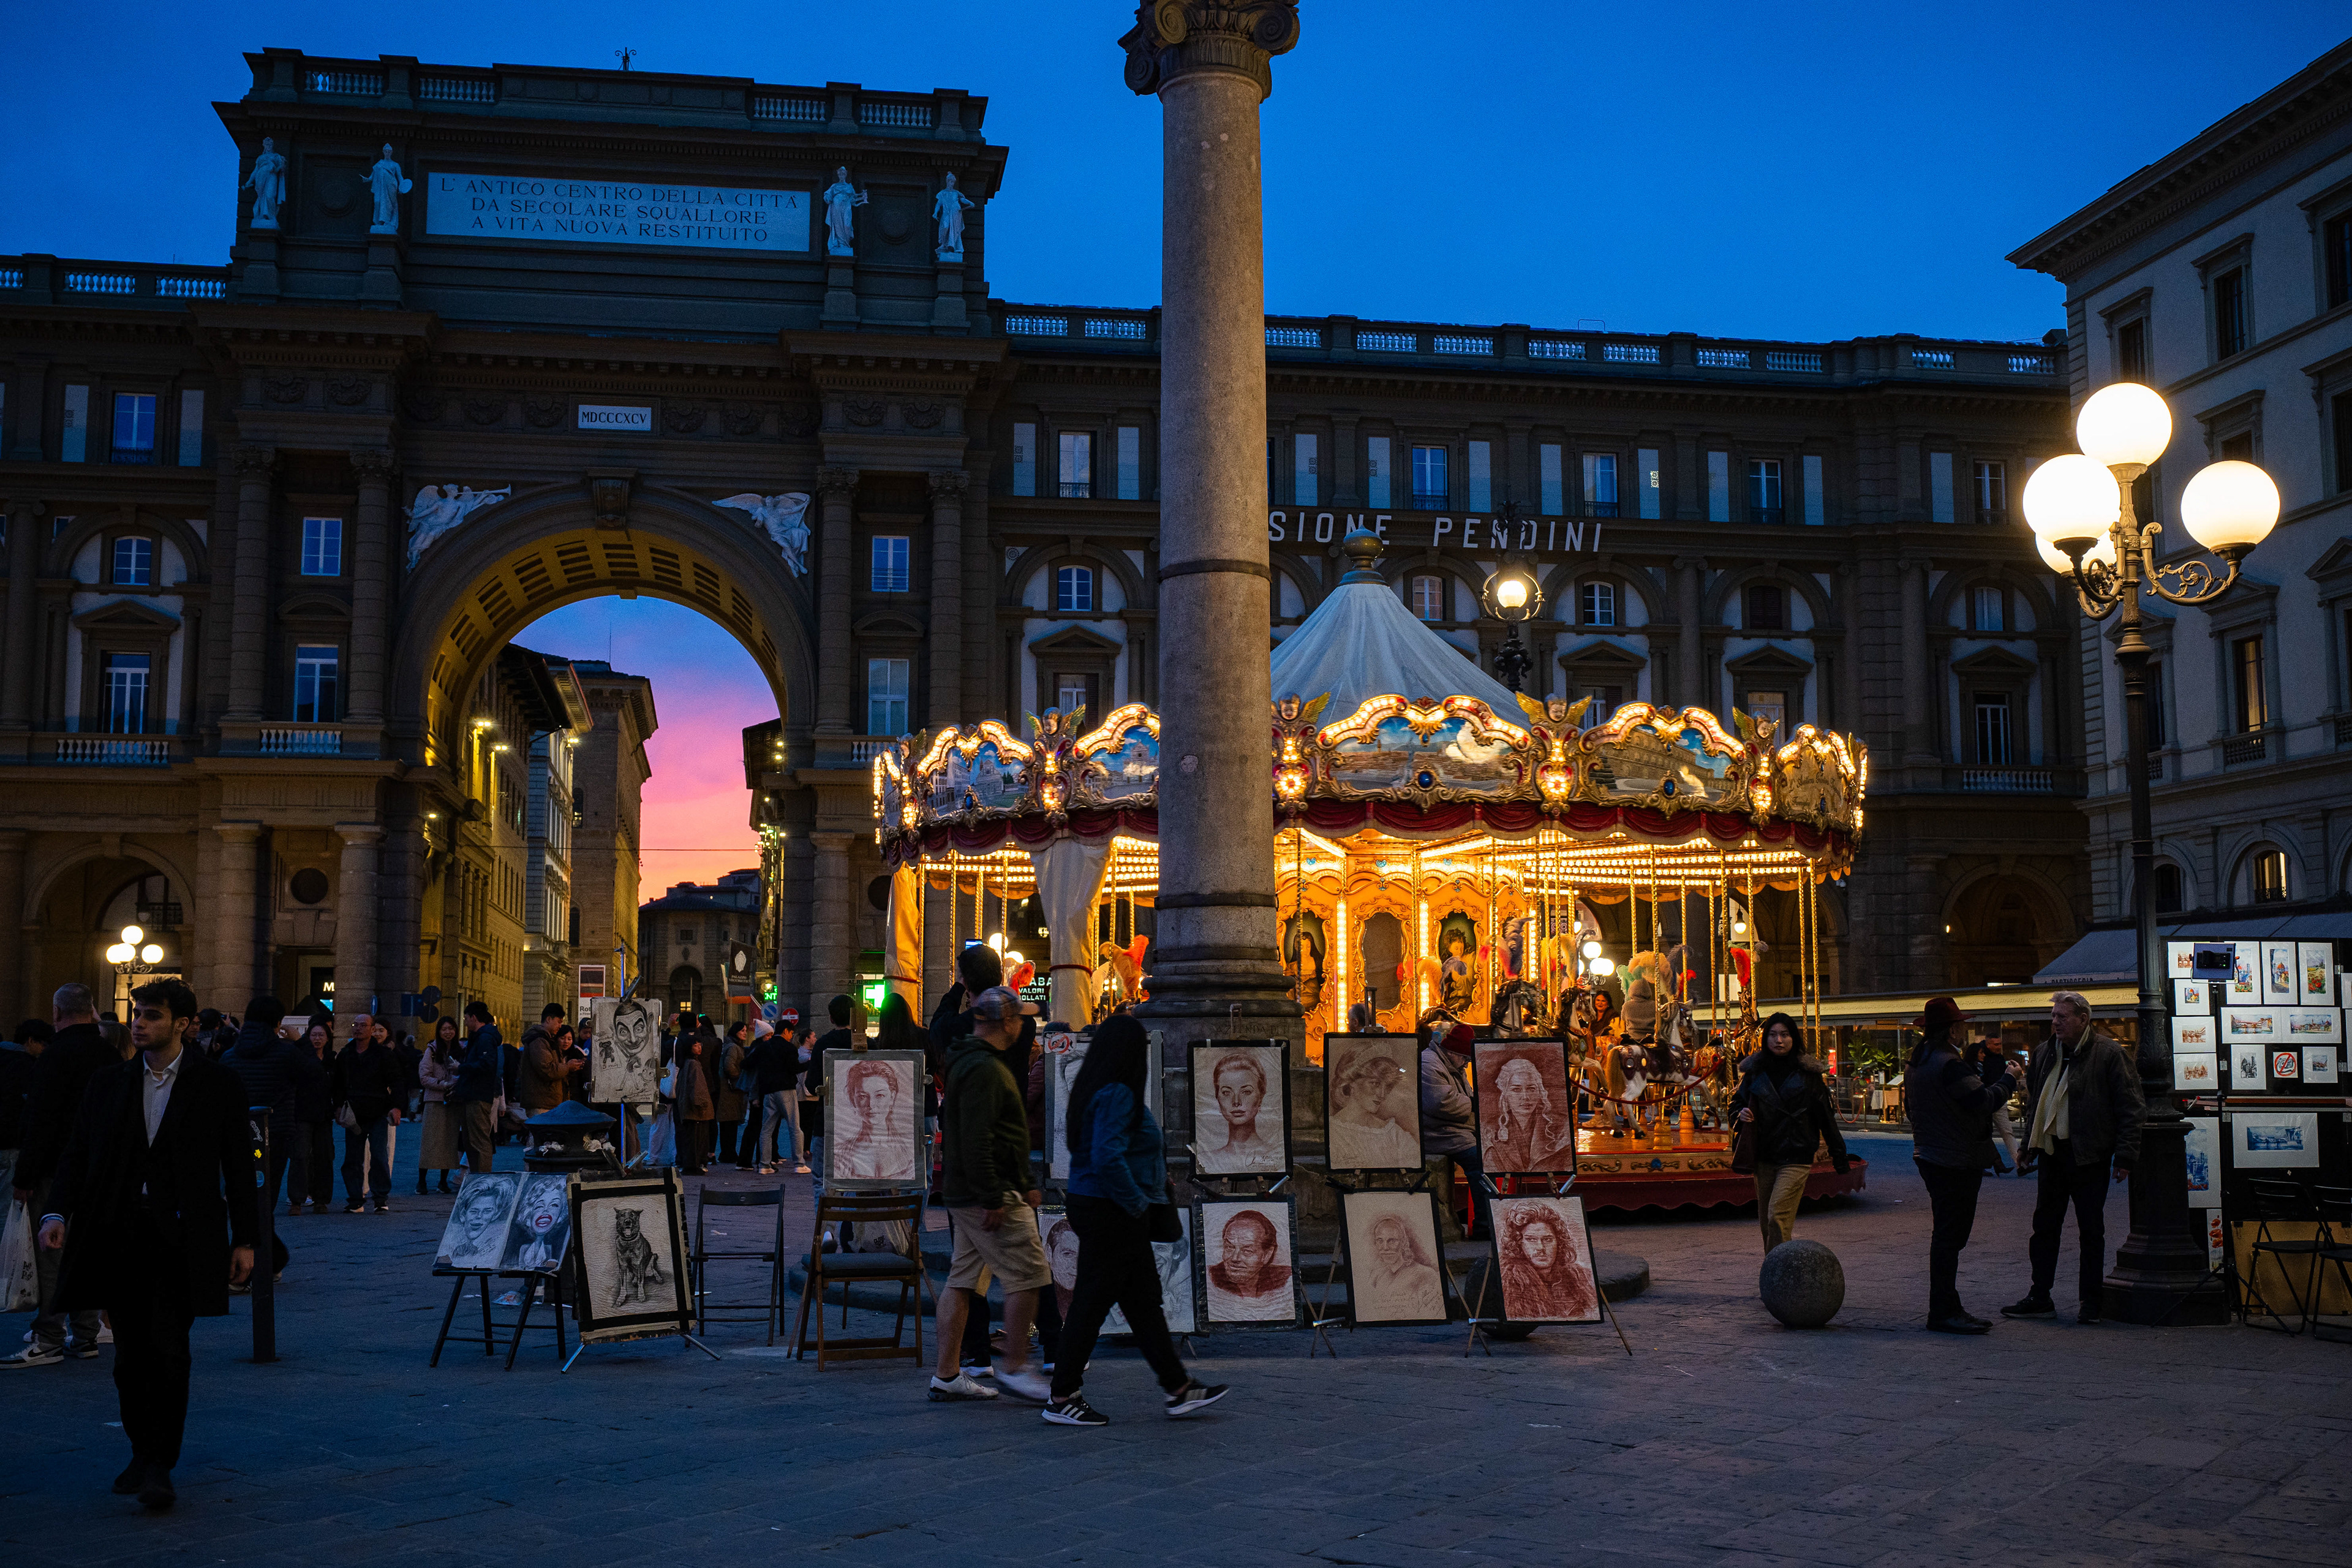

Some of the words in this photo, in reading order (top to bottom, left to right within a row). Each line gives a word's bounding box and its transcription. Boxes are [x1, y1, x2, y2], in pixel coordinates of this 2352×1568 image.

[466, 179, 545, 195] ANTICO
[554, 184, 642, 200] CENTRO
[653, 189, 724, 205] DELLA
[472, 197, 499, 211] DA
[511, 200, 627, 218] SECOLARE
[637, 206, 766, 225] SQUALLORE
[472, 216, 483, 228] A
[496, 217, 543, 232] VITA
[555, 219, 628, 236] NUOVA
[639, 224, 767, 241] RESTITUITO
[581, 412, 647, 424] MDCCCXCV
[1433, 517, 1602, 552] PENDINI
